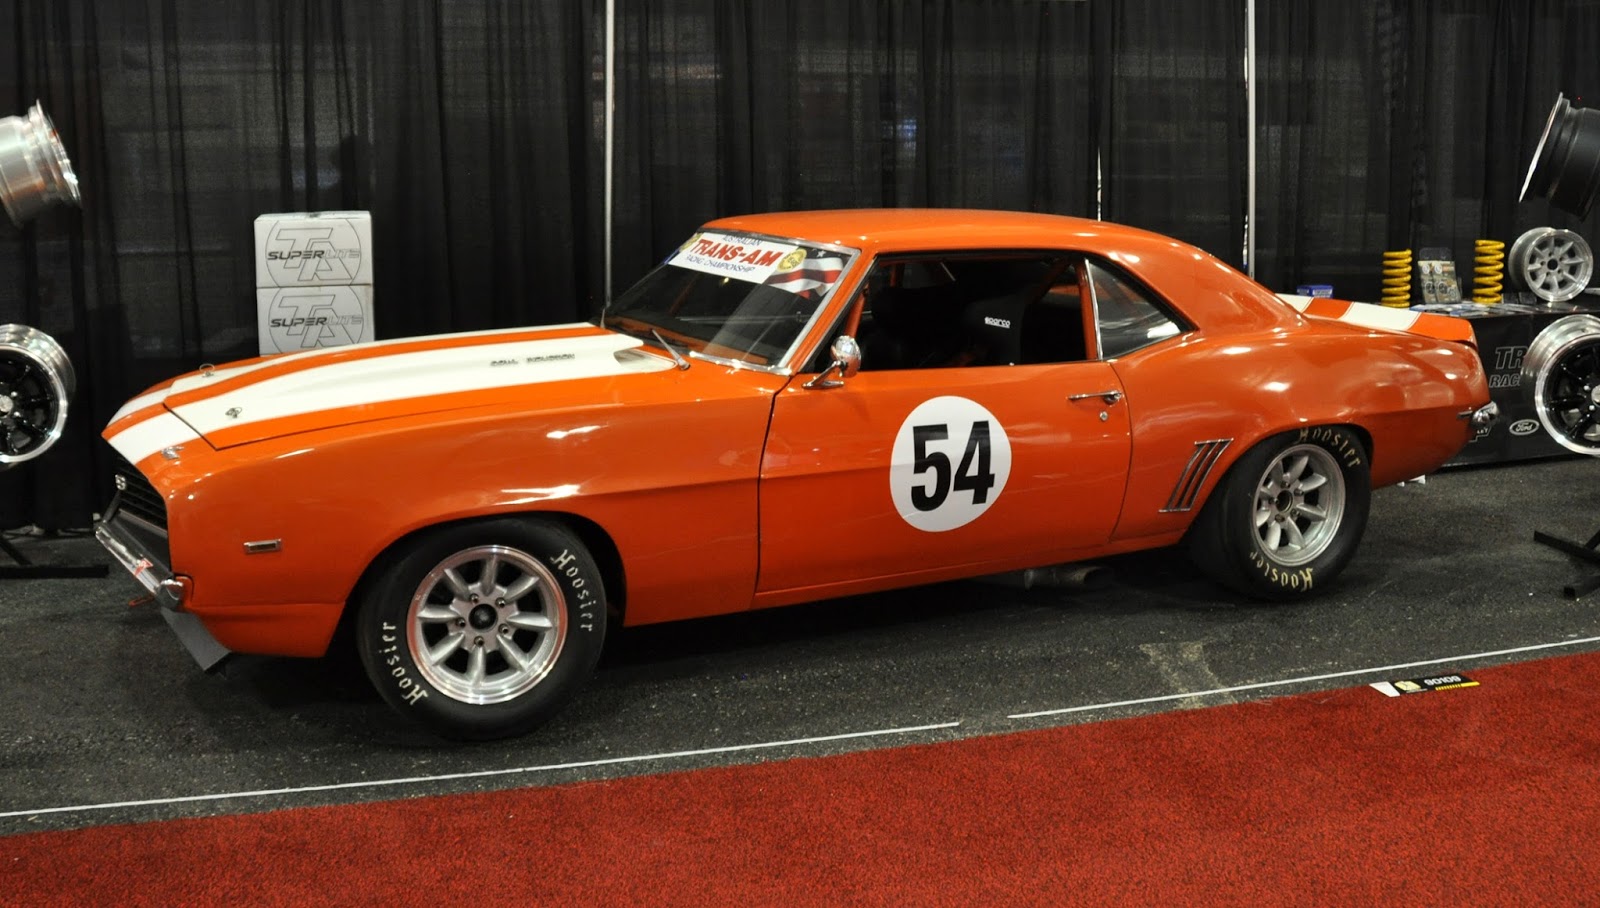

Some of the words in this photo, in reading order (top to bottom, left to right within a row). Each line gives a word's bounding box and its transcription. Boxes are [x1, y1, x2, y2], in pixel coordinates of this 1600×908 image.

[267, 248, 360, 260] SUPERLITE
[690, 239, 784, 267] TRANS-AM
[270, 315, 363, 327] SUPERLITE
[1488, 374, 1520, 388] RAC
[911, 420, 995, 512] 54
[550, 549, 597, 632] Hoosier
[379, 622, 428, 705] Hoosier
